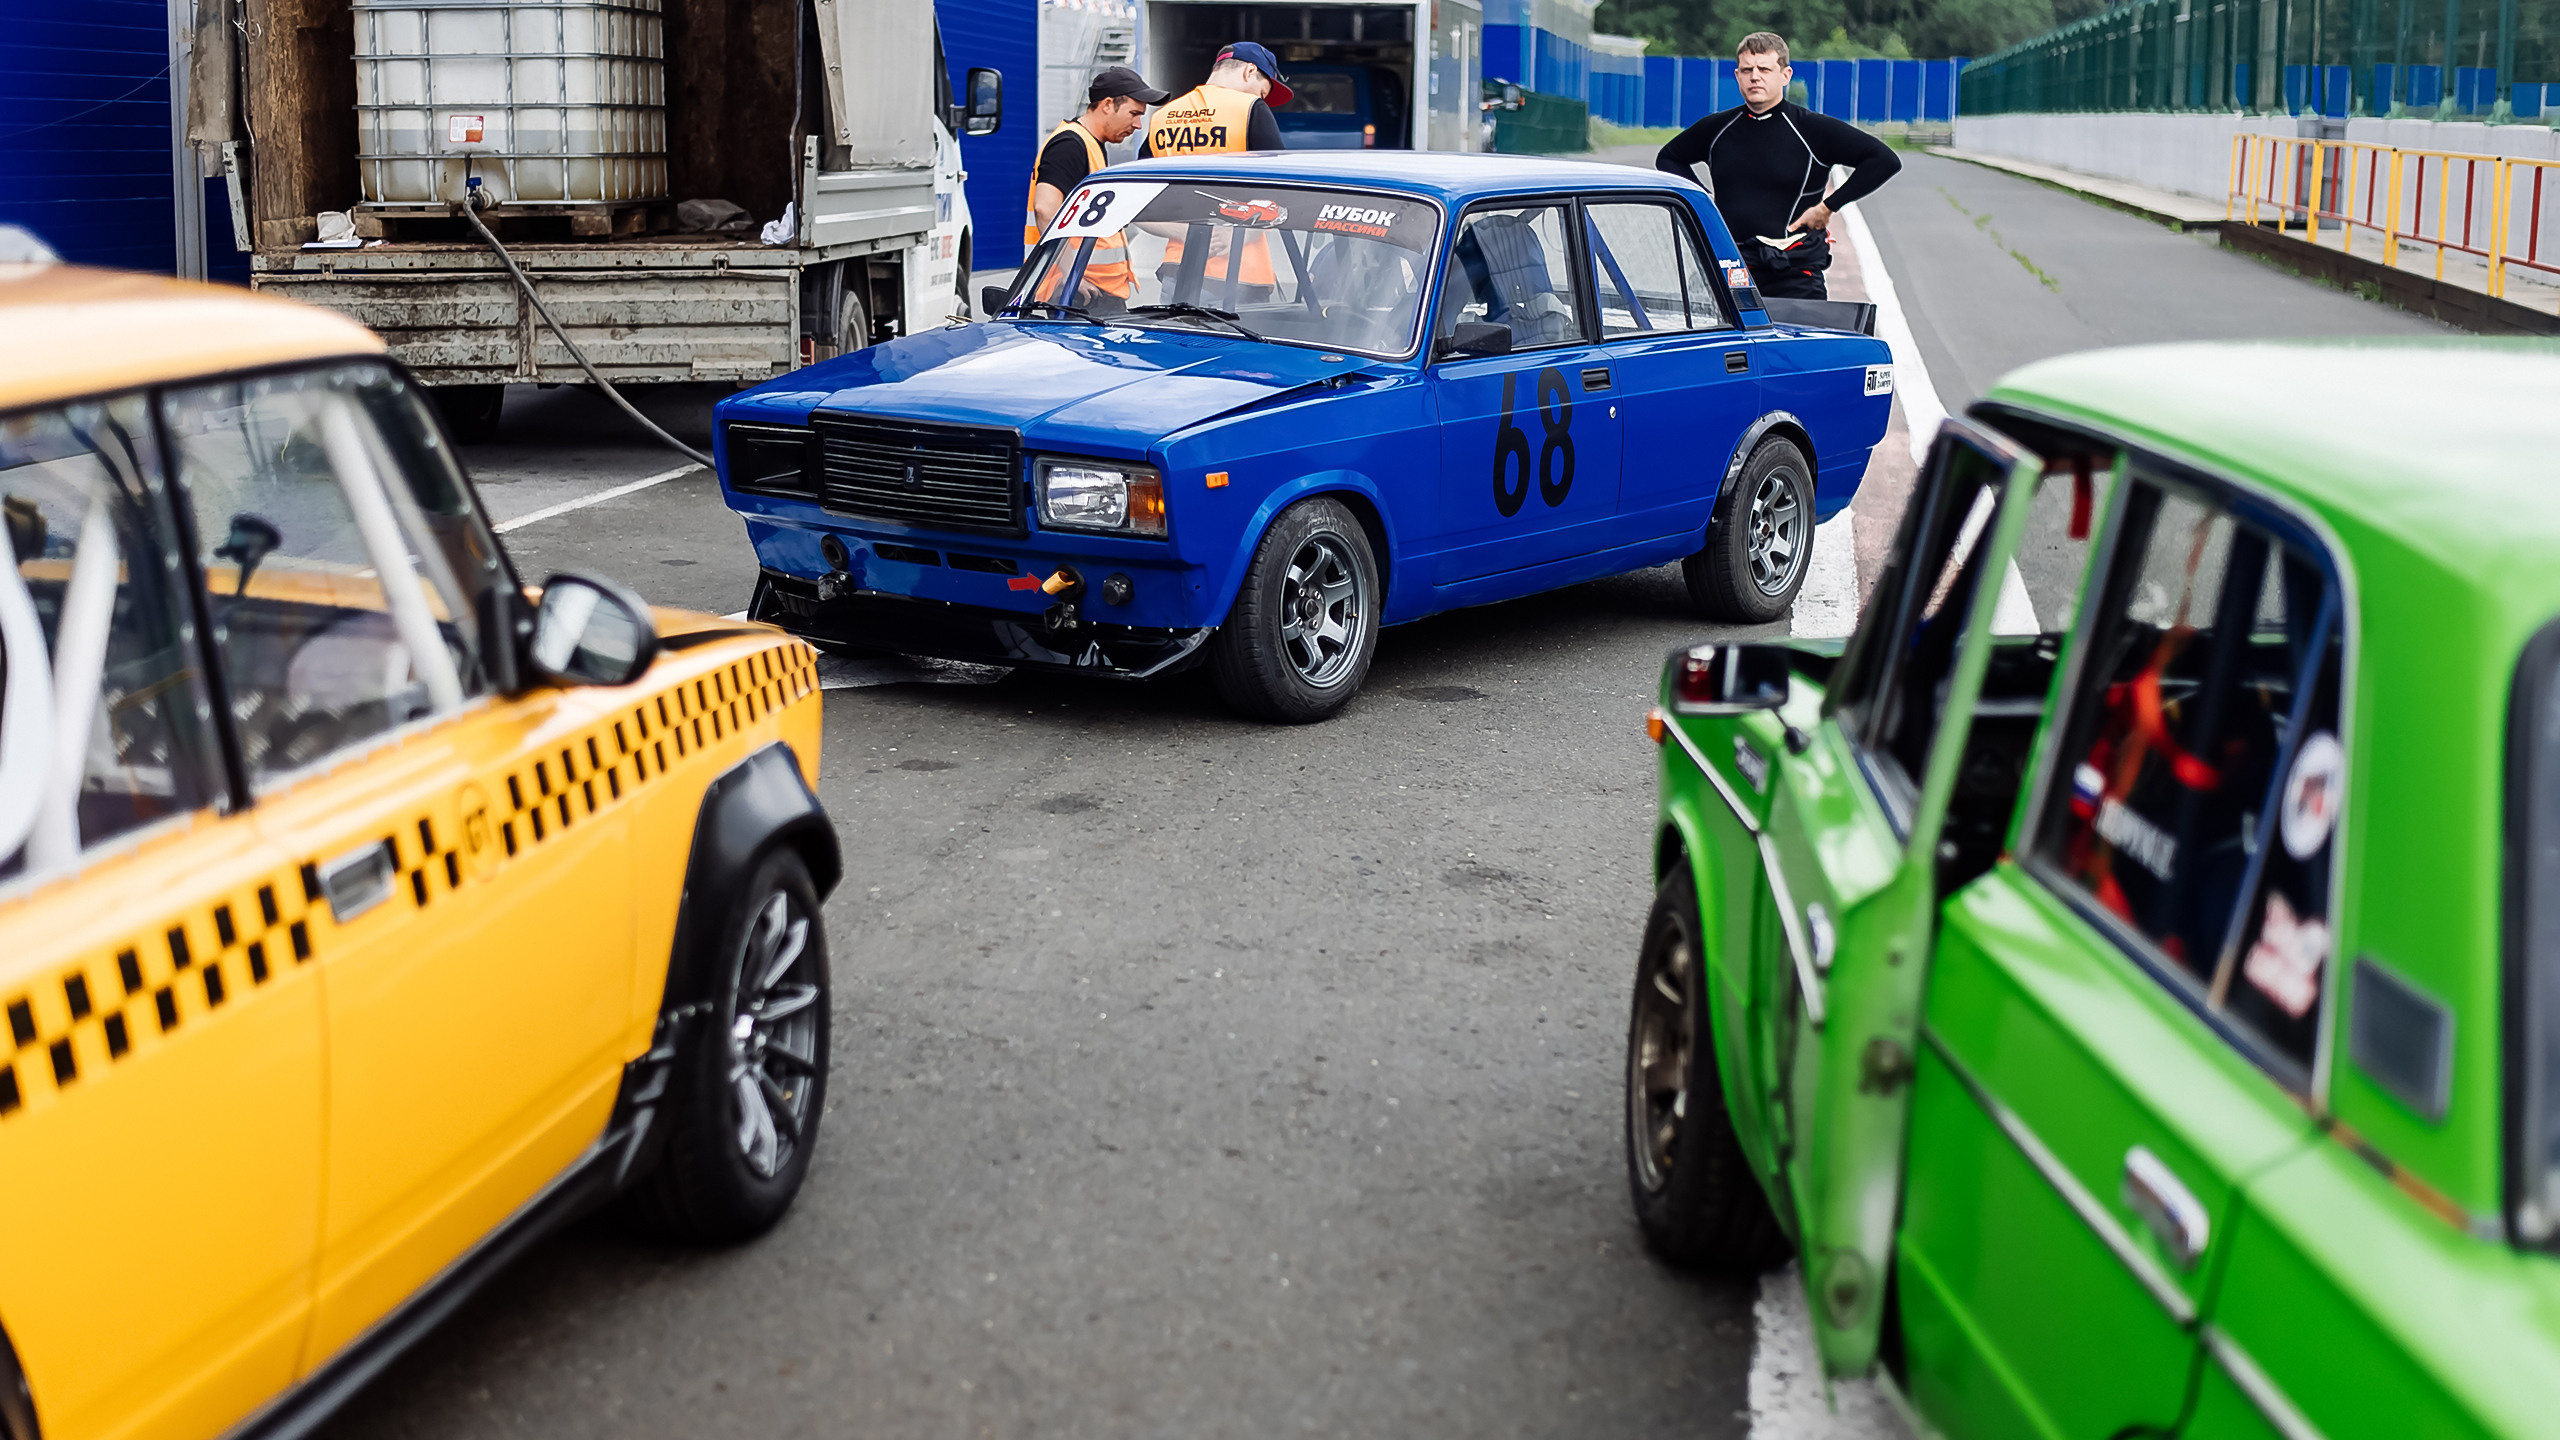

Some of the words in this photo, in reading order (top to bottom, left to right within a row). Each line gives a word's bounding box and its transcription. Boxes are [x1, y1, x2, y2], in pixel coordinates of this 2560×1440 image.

[1167, 108, 1216, 119] SUBARU
[1155, 126, 1228, 152] СУДЬЯ
[1058, 189, 1116, 230] 68
[1318, 204, 1396, 227] КУБОК
[1313, 220, 1388, 238] КЛАССИКИ
[1493, 367, 1576, 518] 68
